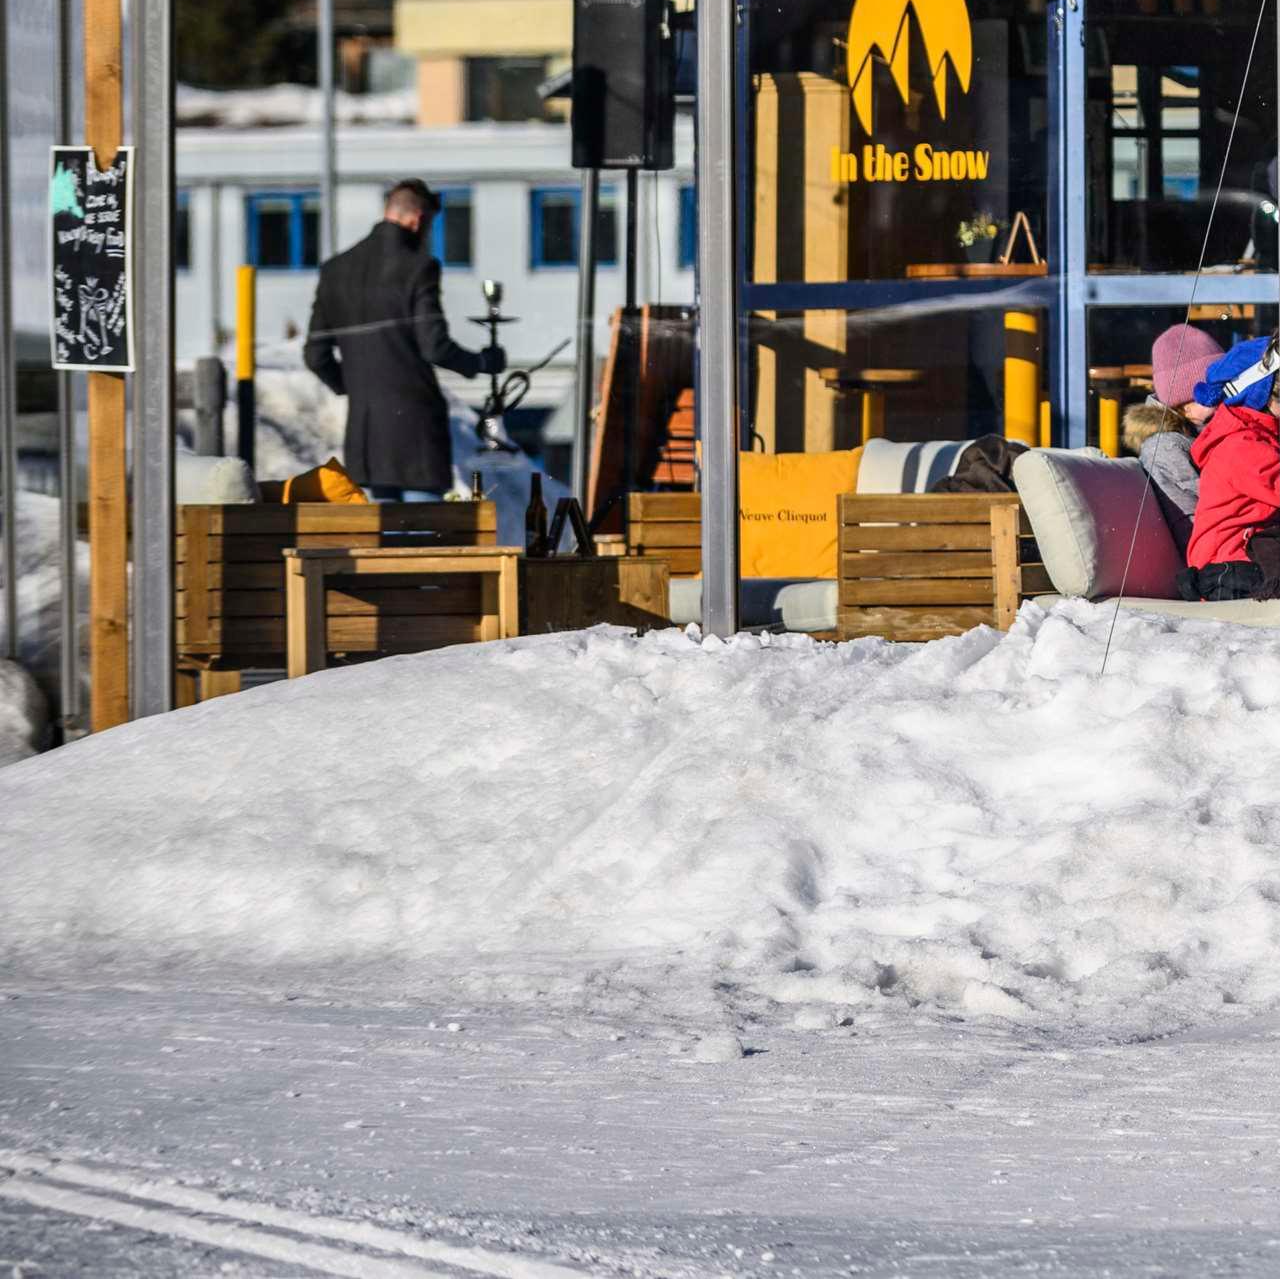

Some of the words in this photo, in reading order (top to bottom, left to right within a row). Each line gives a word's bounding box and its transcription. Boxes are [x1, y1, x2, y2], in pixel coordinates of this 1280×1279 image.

[831, 145, 857, 182] In
[863, 144, 909, 181] the
[914, 143, 989, 181] Snow
[777, 508, 827, 524] Clicquot
